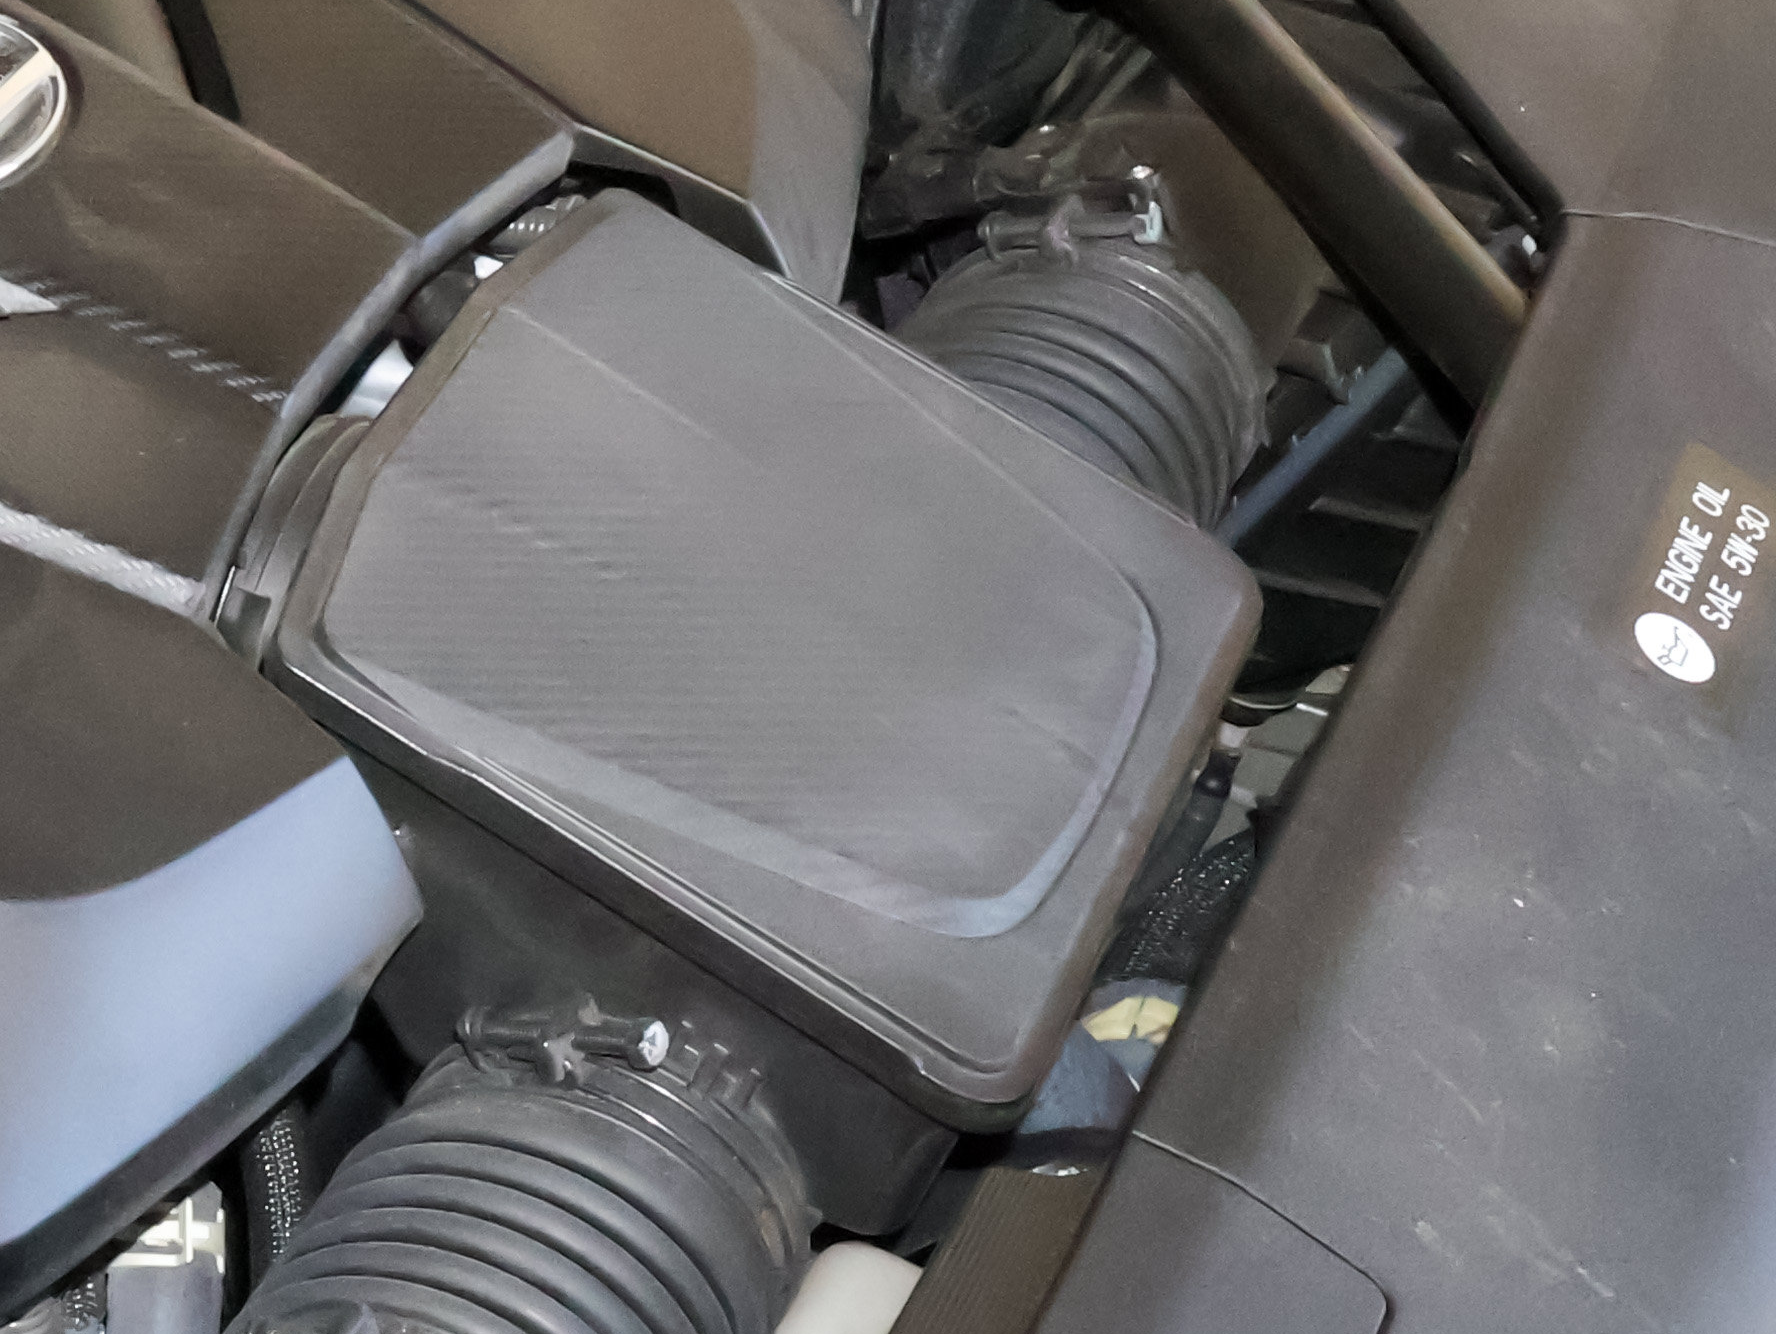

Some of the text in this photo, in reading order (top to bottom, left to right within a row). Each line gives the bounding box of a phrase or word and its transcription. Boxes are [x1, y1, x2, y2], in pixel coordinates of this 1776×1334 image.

[1654, 481, 1731, 604] ENGINE OIL
[1699, 504, 1770, 631] SAE 5W-30
